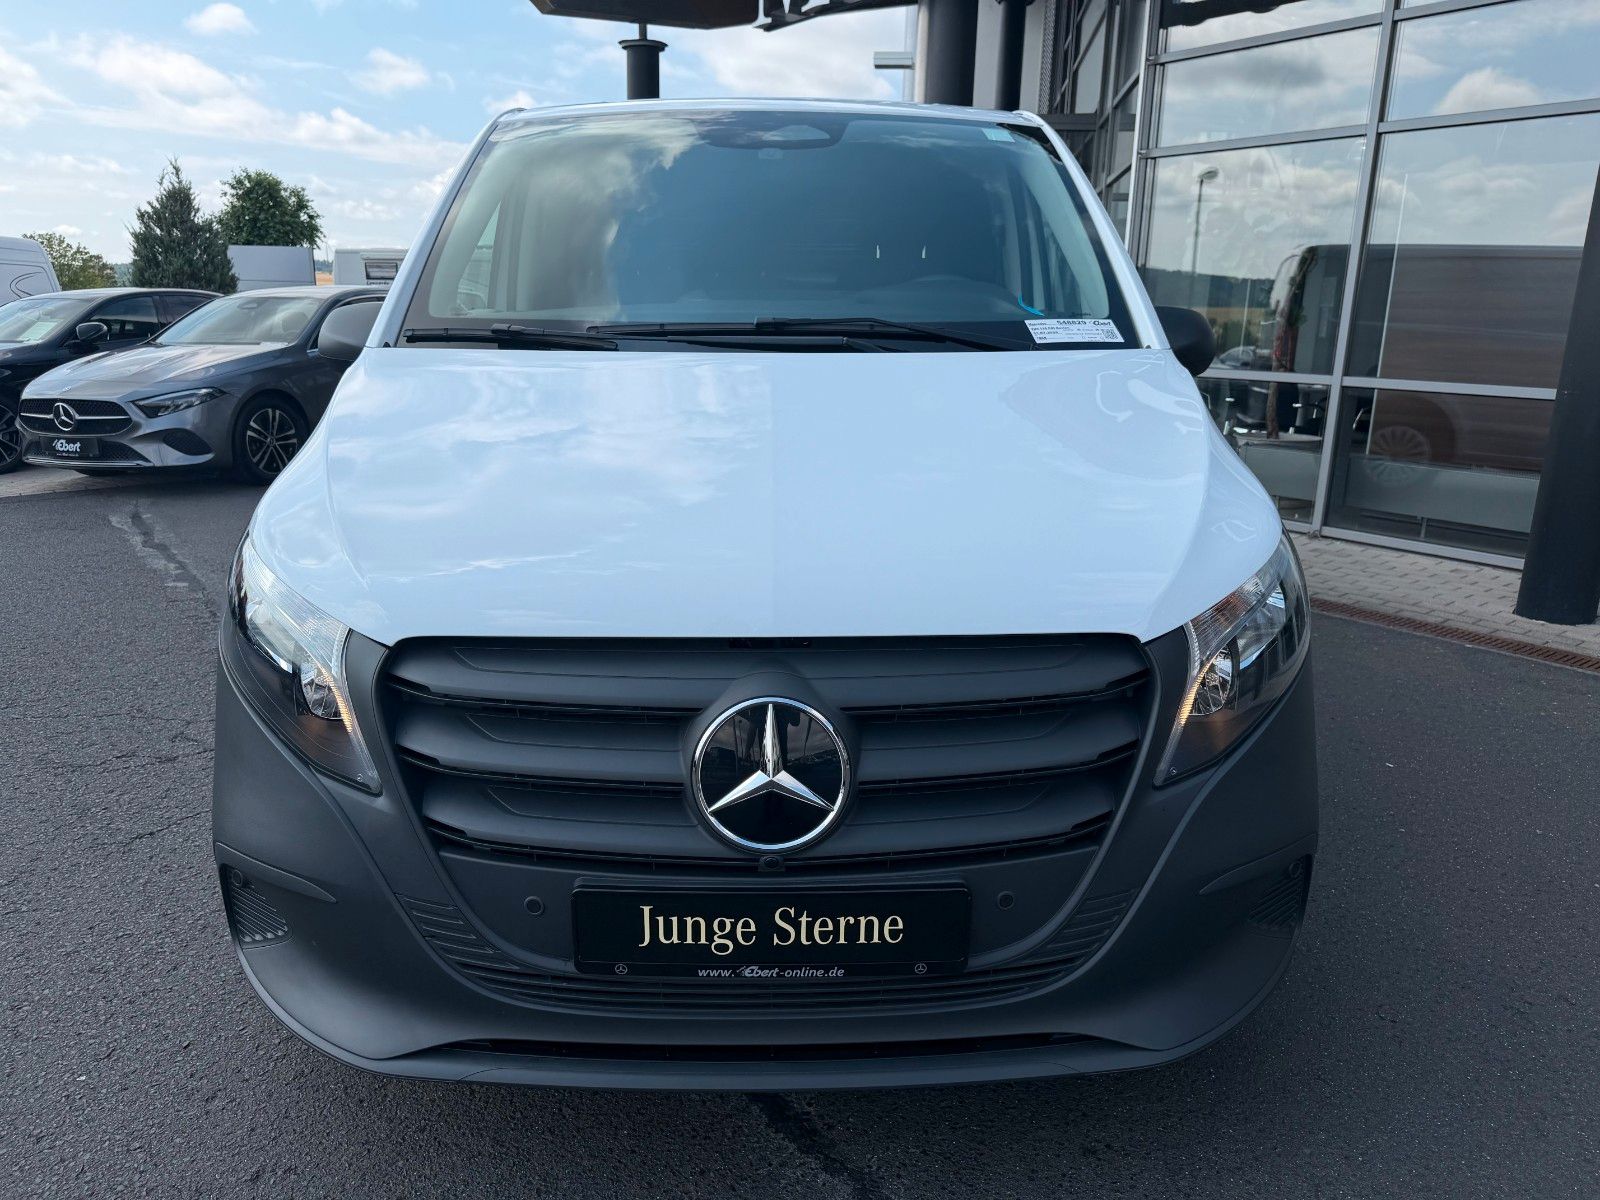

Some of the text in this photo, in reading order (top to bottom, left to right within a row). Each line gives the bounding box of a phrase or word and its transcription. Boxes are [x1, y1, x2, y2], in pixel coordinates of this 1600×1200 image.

[54, 439, 81, 452] Ebert
[639, 905, 904, 955] Junge Sterne
